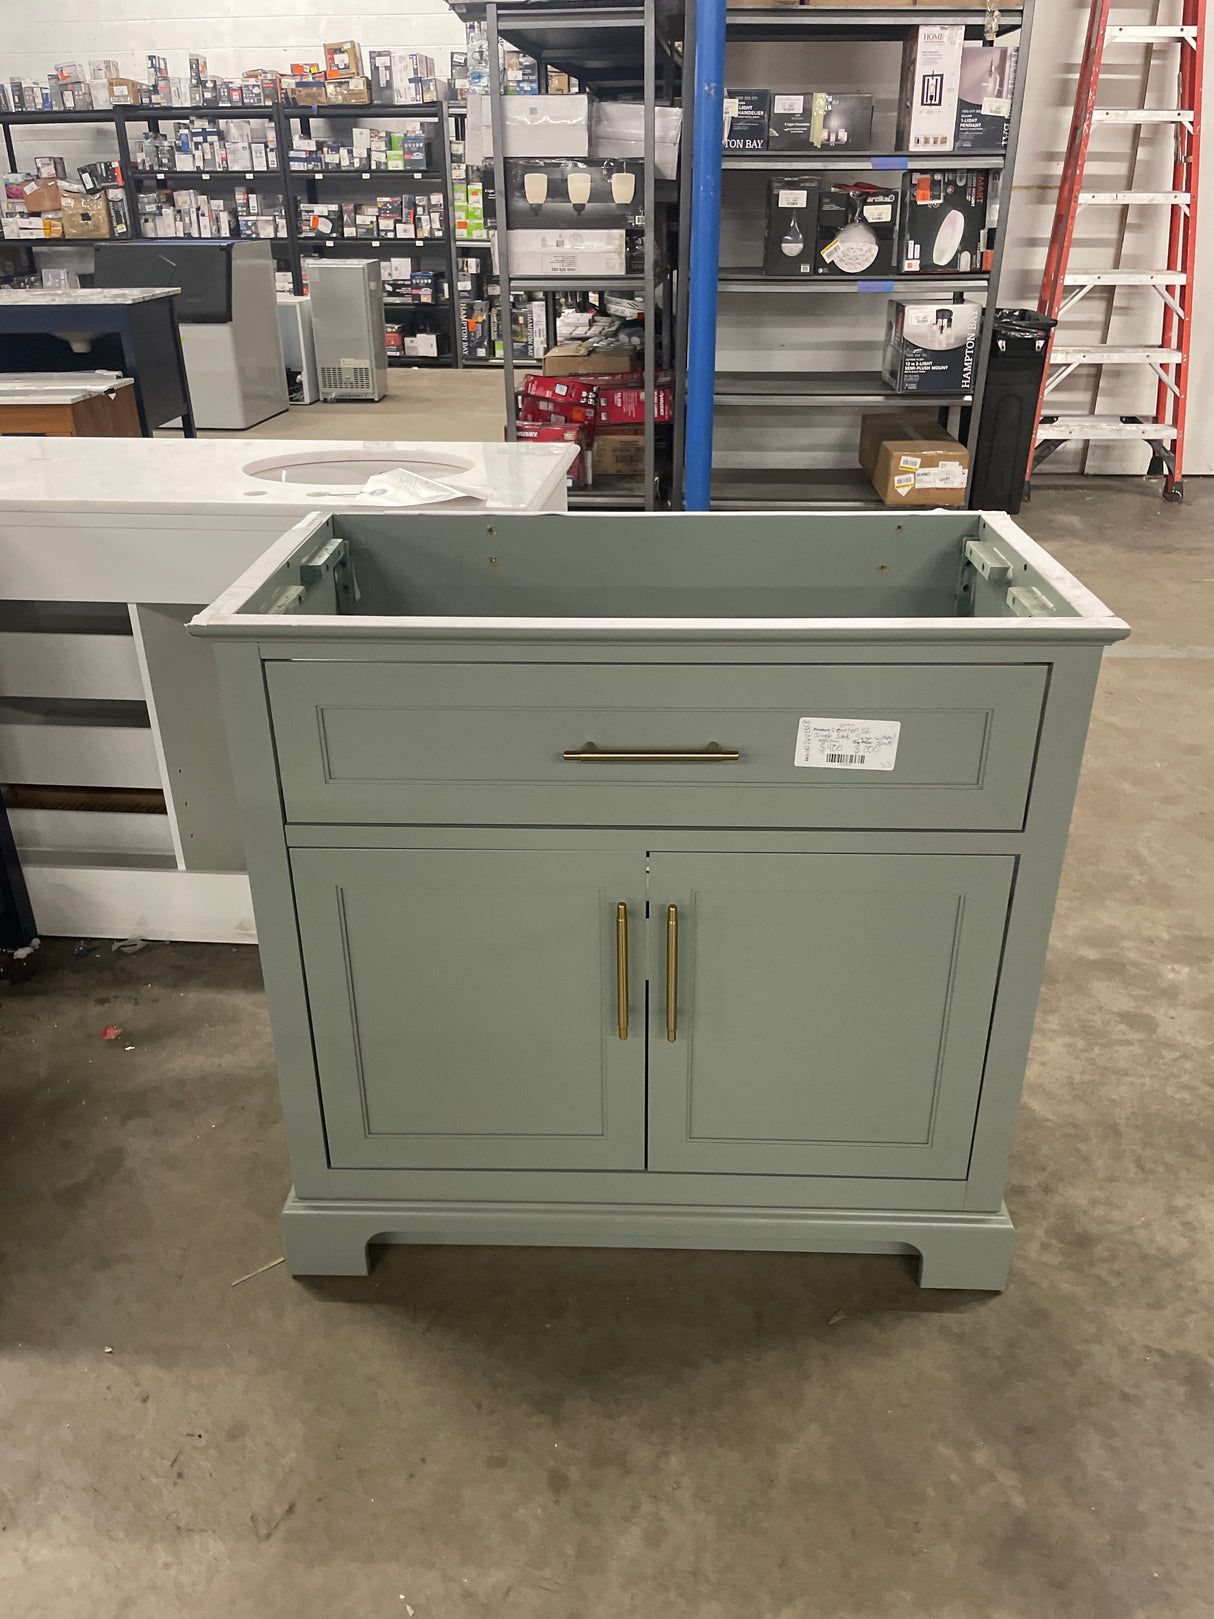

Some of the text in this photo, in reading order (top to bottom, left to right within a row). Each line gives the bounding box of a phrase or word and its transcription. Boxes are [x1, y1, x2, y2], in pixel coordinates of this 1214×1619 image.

[725, 139, 764, 149] TON BAY
[976, 174, 984, 204] MART
[961, 333, 976, 388] HAMPTON
